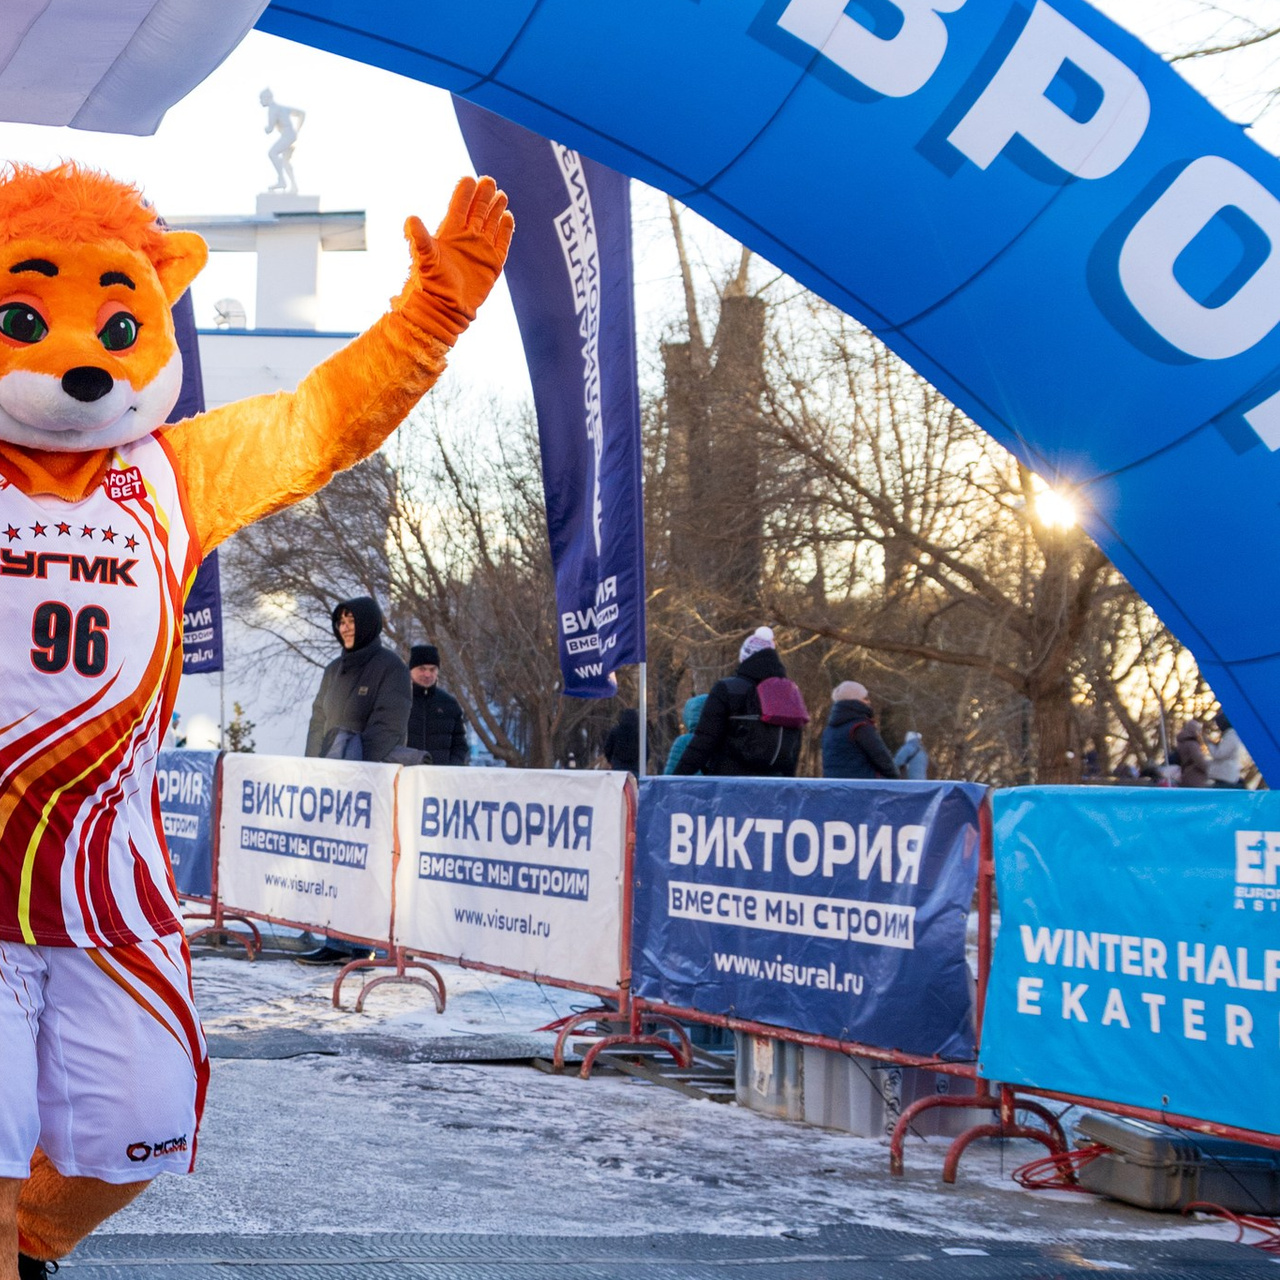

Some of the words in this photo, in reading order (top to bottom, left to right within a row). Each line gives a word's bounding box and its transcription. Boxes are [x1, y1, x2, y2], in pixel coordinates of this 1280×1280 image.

[562, 147, 593, 242] ЖИЗ
[110, 469, 139, 486] FON
[111, 481, 142, 499] BET
[0, 548, 140, 587] УГМК
[30, 600, 110, 679] 96
[241, 780, 373, 829] ВИКТОРИЯ
[421, 796, 594, 851] ВИКТОРИЯ
[241, 829, 286, 853] вместе
[288, 838, 311, 856] мы
[312, 841, 367, 866] строим
[669, 813, 927, 885] ВИКТОРИЯ
[264, 872, 338, 899] www.visural.ru
[420, 854, 484, 882] вместе
[487, 863, 513, 886] мы
[518, 866, 588, 896] строим
[454, 907, 551, 938] www.visural.ru
[671, 887, 757, 919] вместе
[765, 898, 805, 927] мы
[812, 902, 910, 941] строим
[714, 952, 864, 996] www.visural.ru
[1020, 924, 1168, 979] WINTER
[1017, 976, 1279, 1049] EKATER
